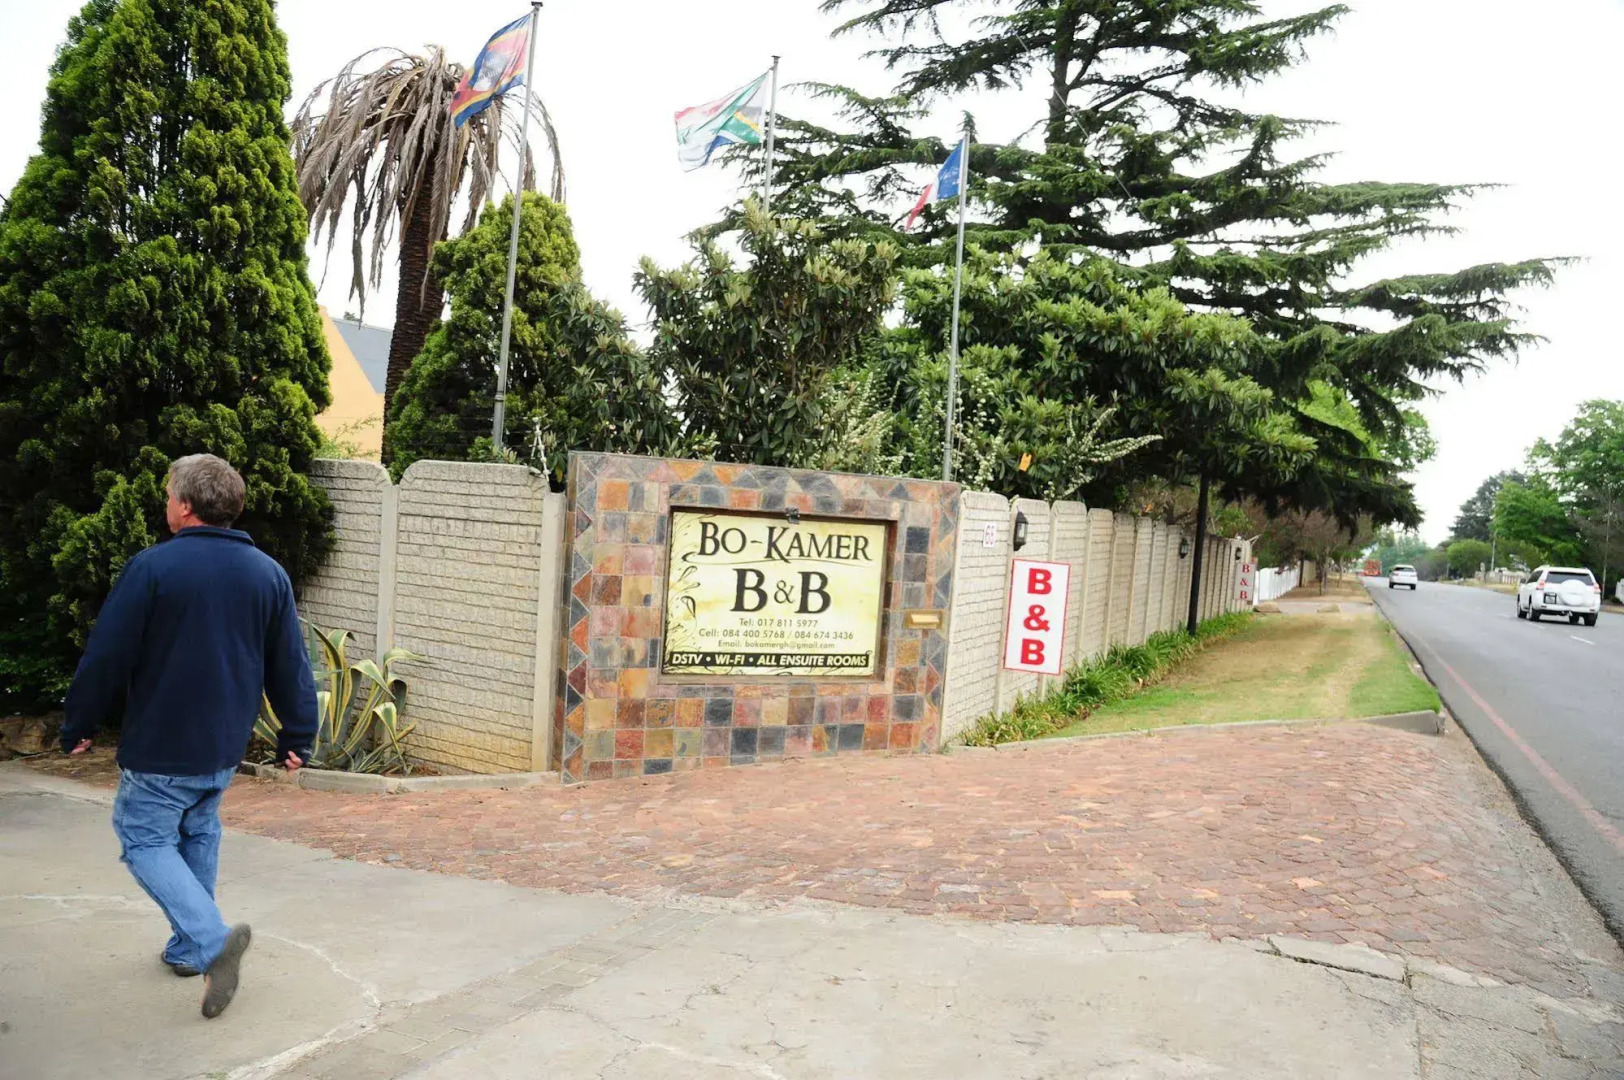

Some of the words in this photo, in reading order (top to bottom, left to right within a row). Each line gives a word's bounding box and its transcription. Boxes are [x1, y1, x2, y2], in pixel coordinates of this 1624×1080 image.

[698, 522, 872, 563] BO-KAMER
[739, 618, 754, 627] Tel:
[757, 618, 774, 627] 017
[777, 619, 793, 627] 811
[797, 619, 818, 627] 5977
[698, 628, 719, 637] Cell:
[722, 629, 740, 637] 084
[743, 629, 760, 638] 400
[763, 630, 785, 638] 5768
[794, 631, 811, 639] 084
[813, 631, 830, 639] 674
[832, 631, 853, 639] 3436
[672, 653, 703, 664] DSTV
[715, 653, 745, 665] WI-FI
[757, 654, 777, 665] ALL
[779, 655, 825, 666] ENSUITE
[827, 655, 867, 666] ROOMS
